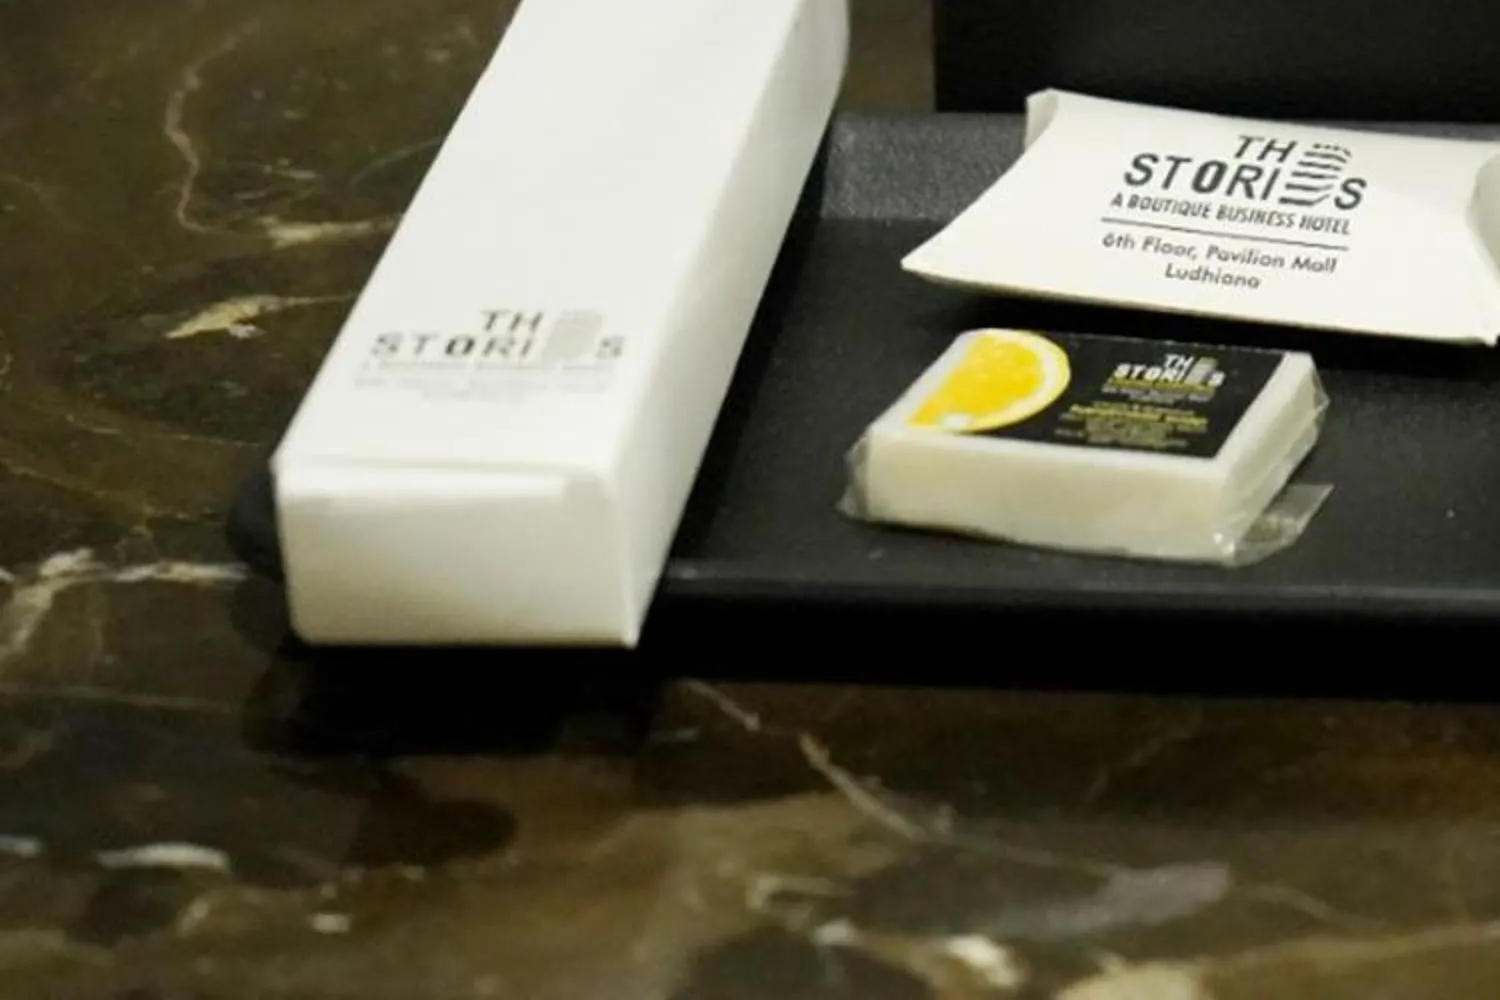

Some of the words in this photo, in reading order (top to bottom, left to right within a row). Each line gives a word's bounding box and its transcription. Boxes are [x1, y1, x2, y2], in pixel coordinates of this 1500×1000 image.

[1124, 153, 1367, 209] STORIES
[1110, 192, 1123, 207] A
[1128, 194, 1212, 219] BOUTIQUE
[1216, 204, 1294, 228] BUSINESS
[1299, 214, 1350, 235] HOTEL
[1102, 232, 1136, 250] 6th
[1141, 235, 1198, 260] Floor,
[1206, 244, 1285, 269] Pavilion
[1292, 257, 1338, 275] Mall
[1165, 263, 1261, 290] Ludhiana
[371, 331, 626, 359] STORIS
[1114, 362, 1227, 388] STORIS
